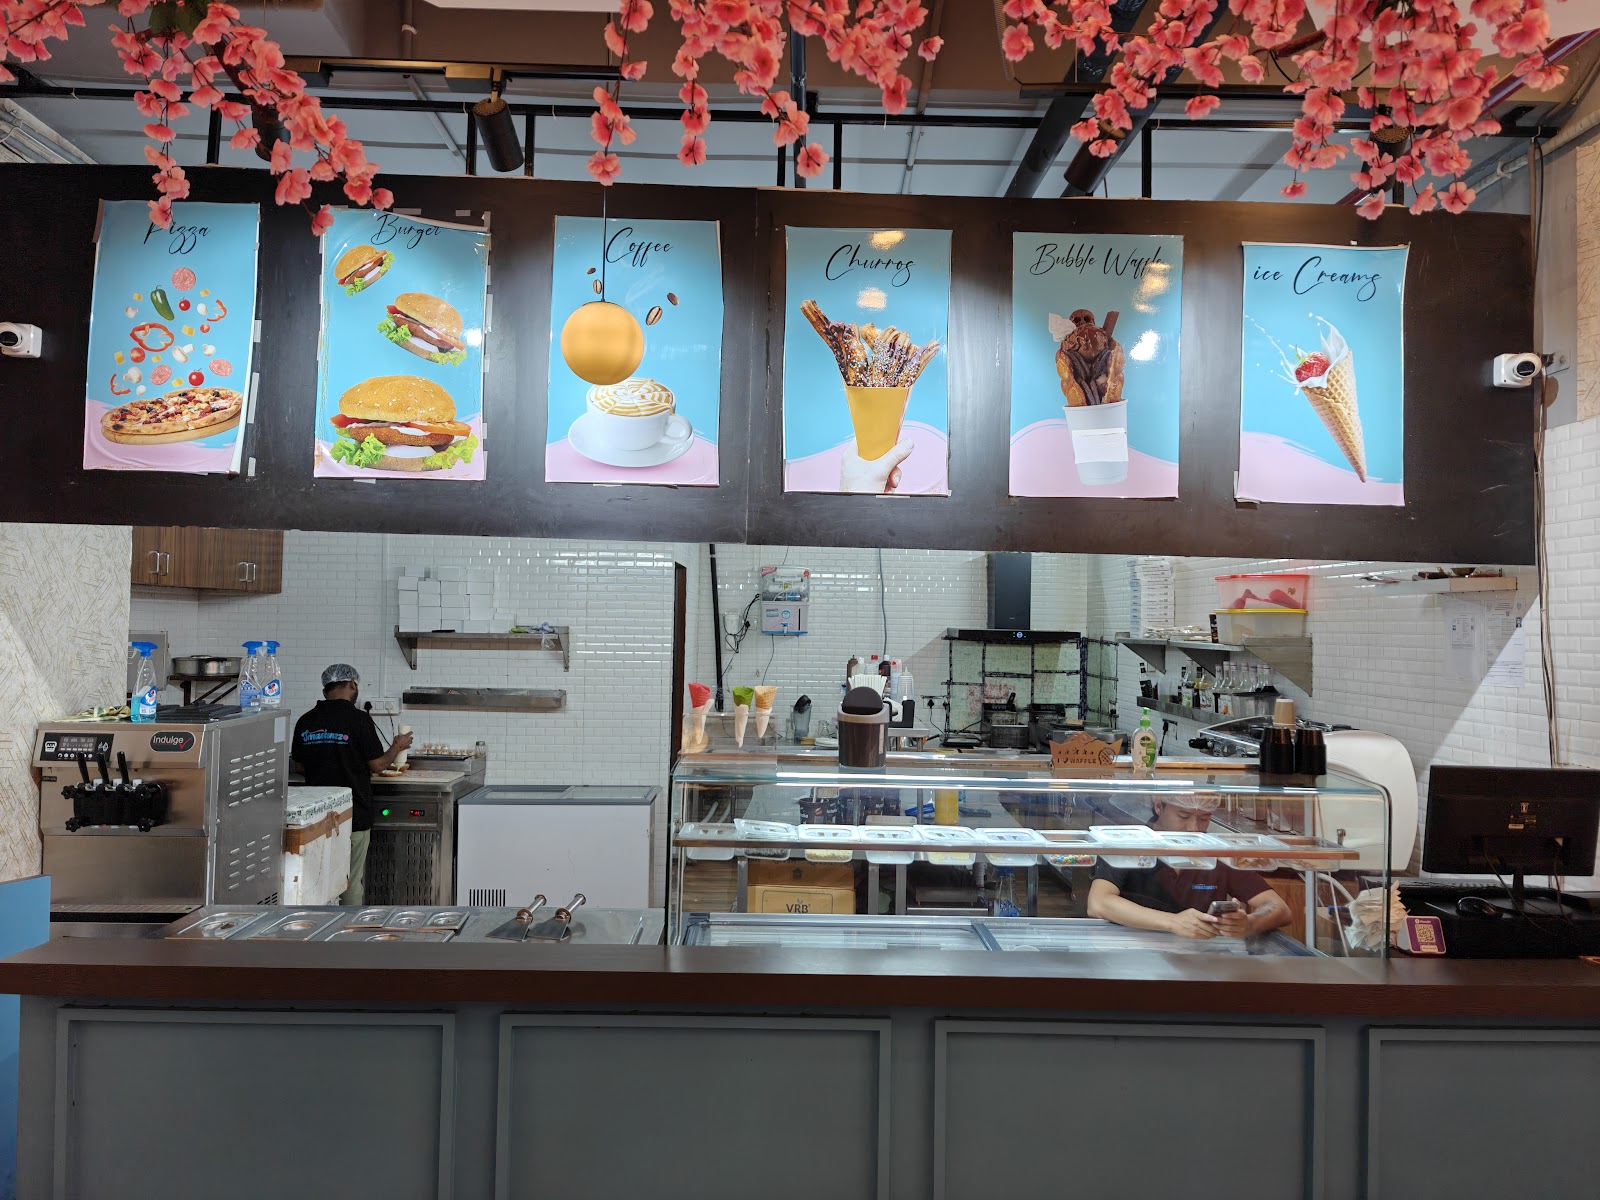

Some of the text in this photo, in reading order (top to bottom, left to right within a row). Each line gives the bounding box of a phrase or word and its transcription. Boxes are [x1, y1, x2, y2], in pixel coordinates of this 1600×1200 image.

[370, 213, 441, 250] Burger
[605, 226, 674, 268] Coffee
[825, 243, 916, 288] Churros
[1029, 243, 1098, 276] Bubble
[1253, 255, 1382, 302] ice Creams
[153, 735, 184, 746] Indulge
[785, 903, 809, 914] VRB
